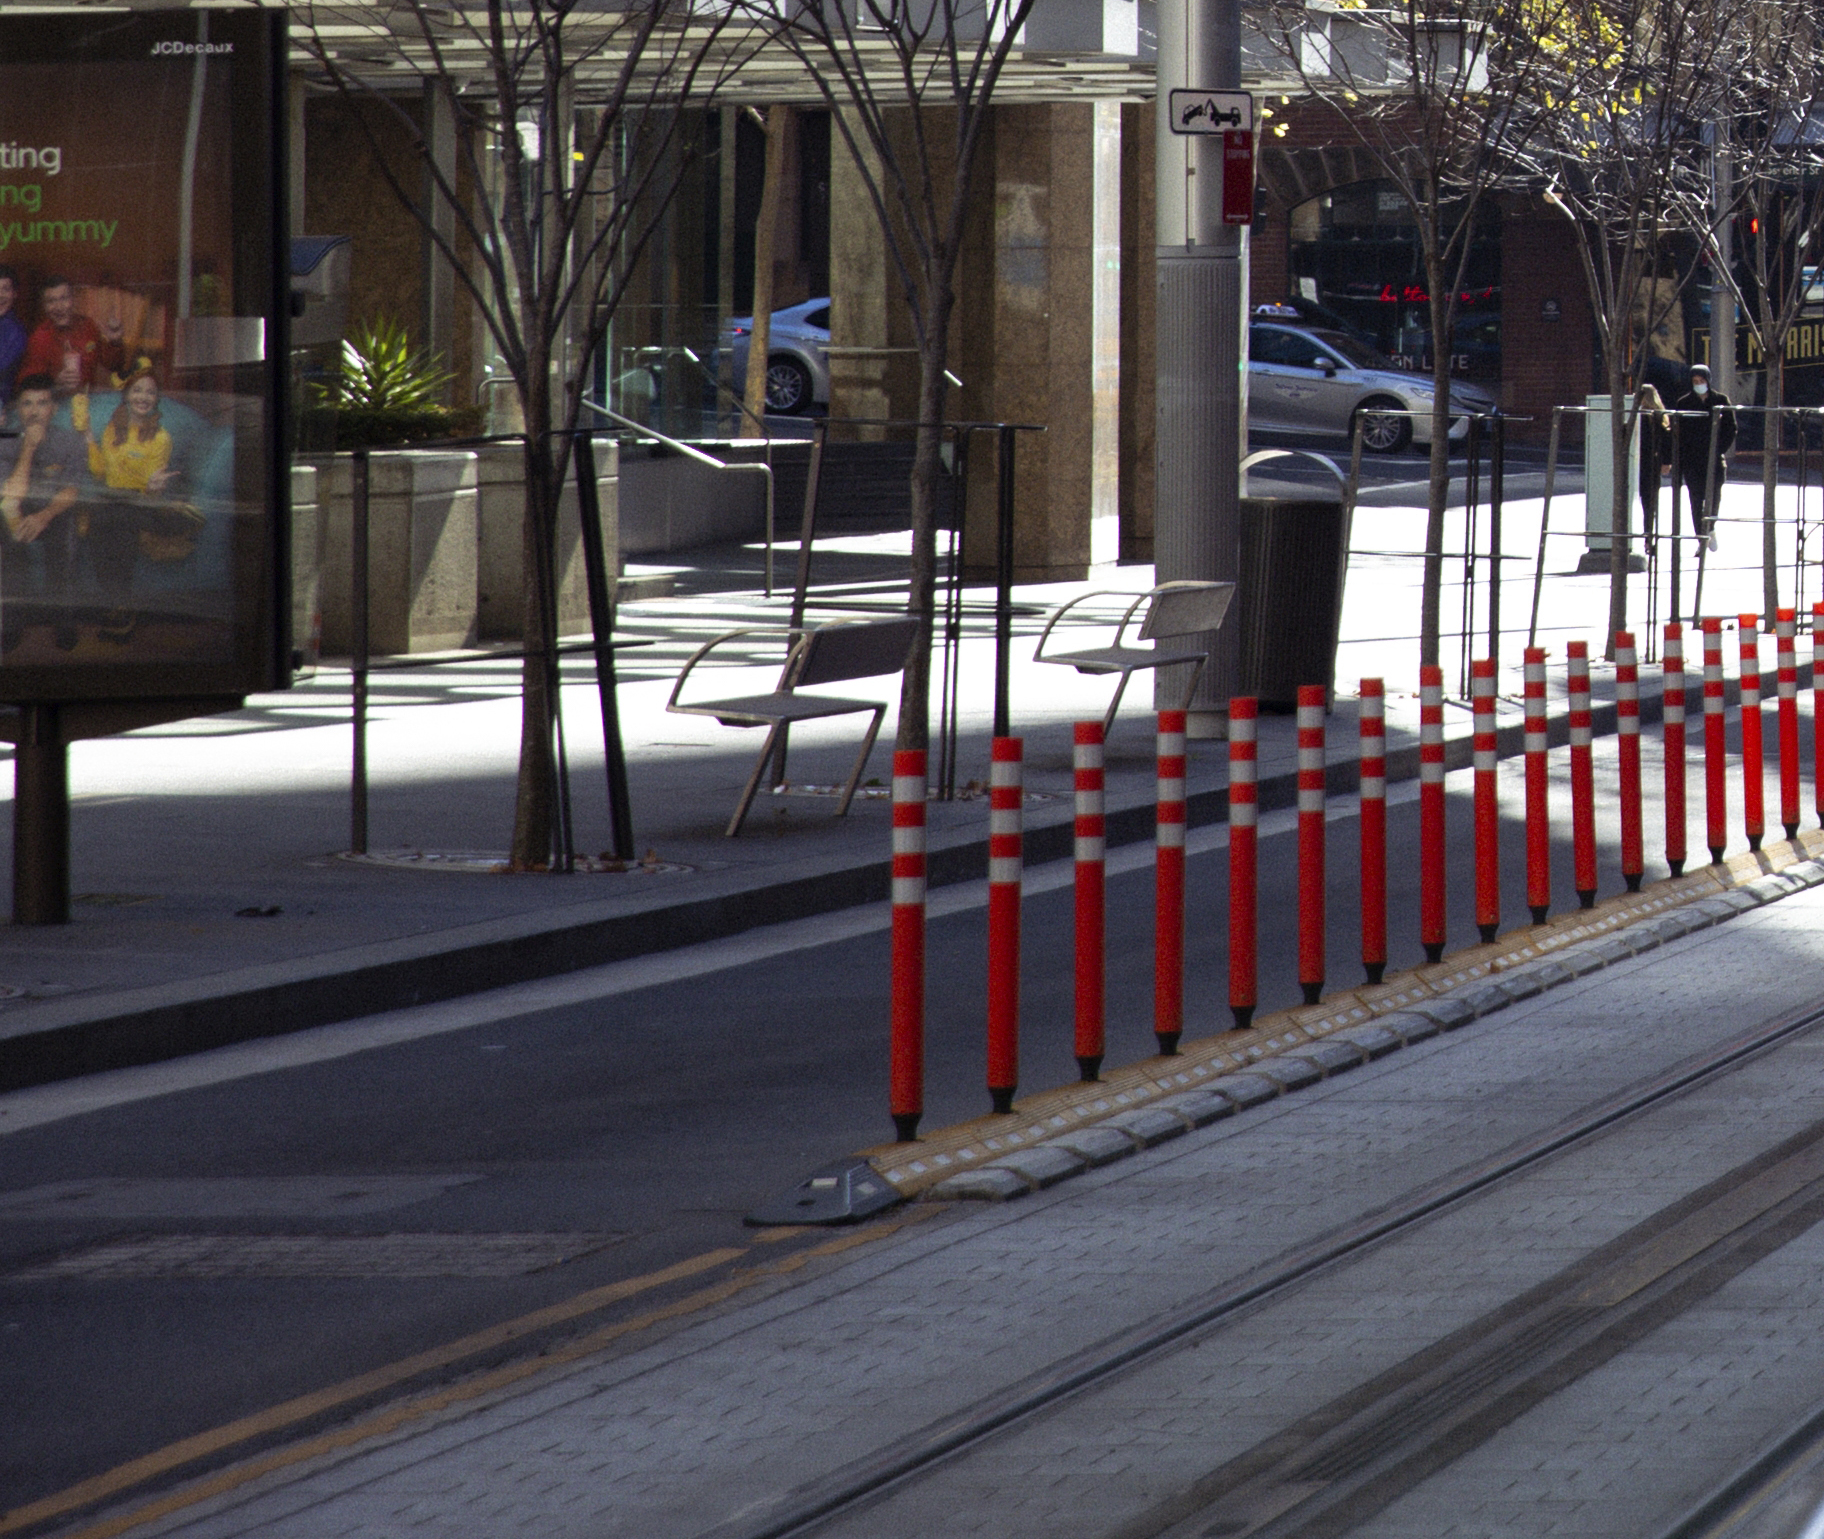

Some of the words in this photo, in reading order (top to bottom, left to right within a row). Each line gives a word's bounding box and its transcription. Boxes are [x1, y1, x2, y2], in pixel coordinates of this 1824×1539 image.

[151, 41, 235, 55] JCDecaux
[0, 140, 62, 176] ting
[0, 219, 119, 250] yummy
[1421, 355, 1469, 370] LTE
